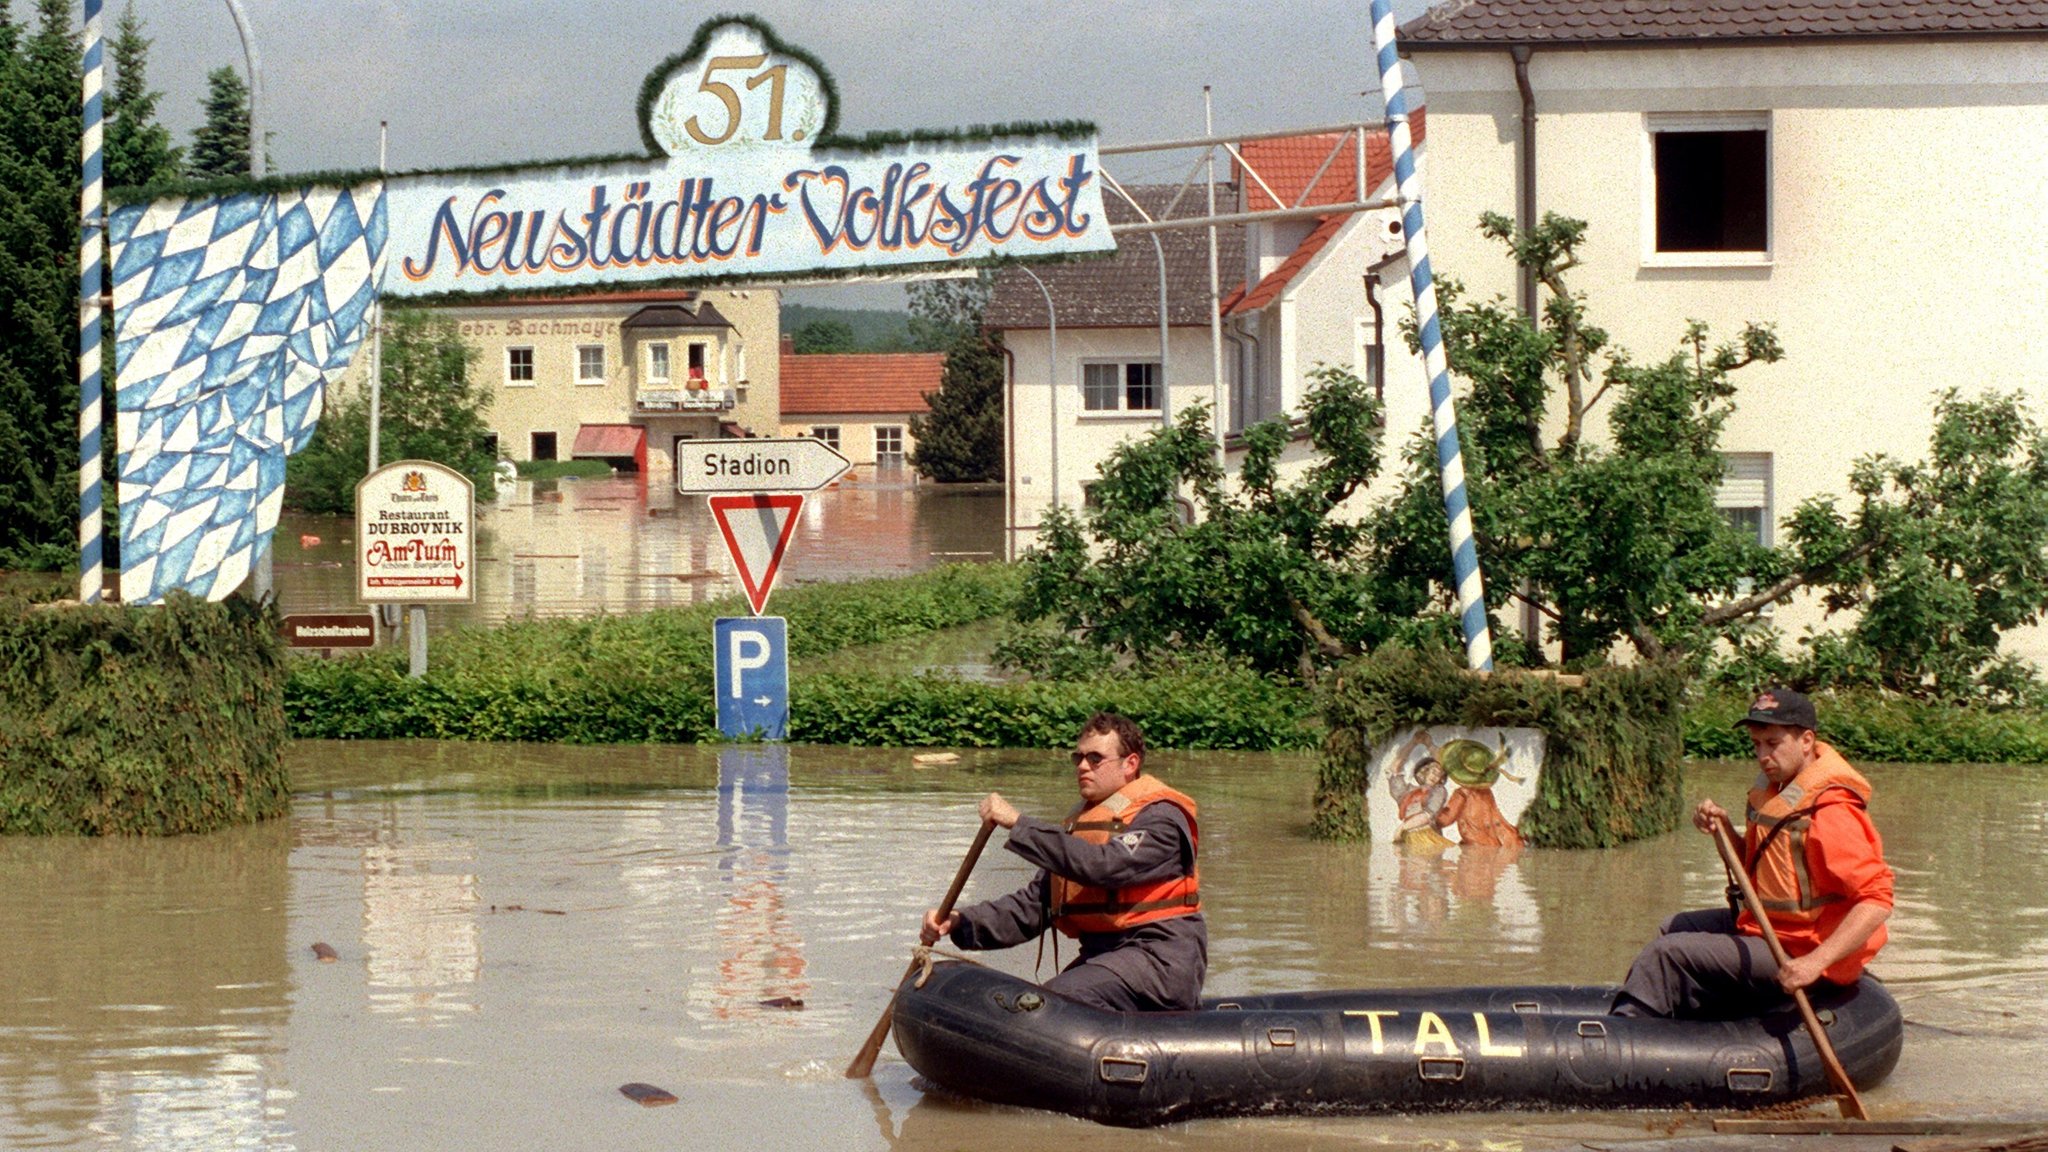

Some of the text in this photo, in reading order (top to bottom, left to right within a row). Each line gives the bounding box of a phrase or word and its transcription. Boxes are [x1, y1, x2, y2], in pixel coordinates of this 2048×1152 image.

[684, 53, 805, 145] 51.
[402, 154, 1093, 282] Neustädter Volksfest
[704, 453, 790, 477] Stadion
[368, 523, 463, 534] DUBROVNIK
[379, 510, 450, 520] Restaurant
[367, 538, 464, 569] Am Turm
[730, 630, 771, 699] P
[1344, 1011, 1522, 1057] TAL
